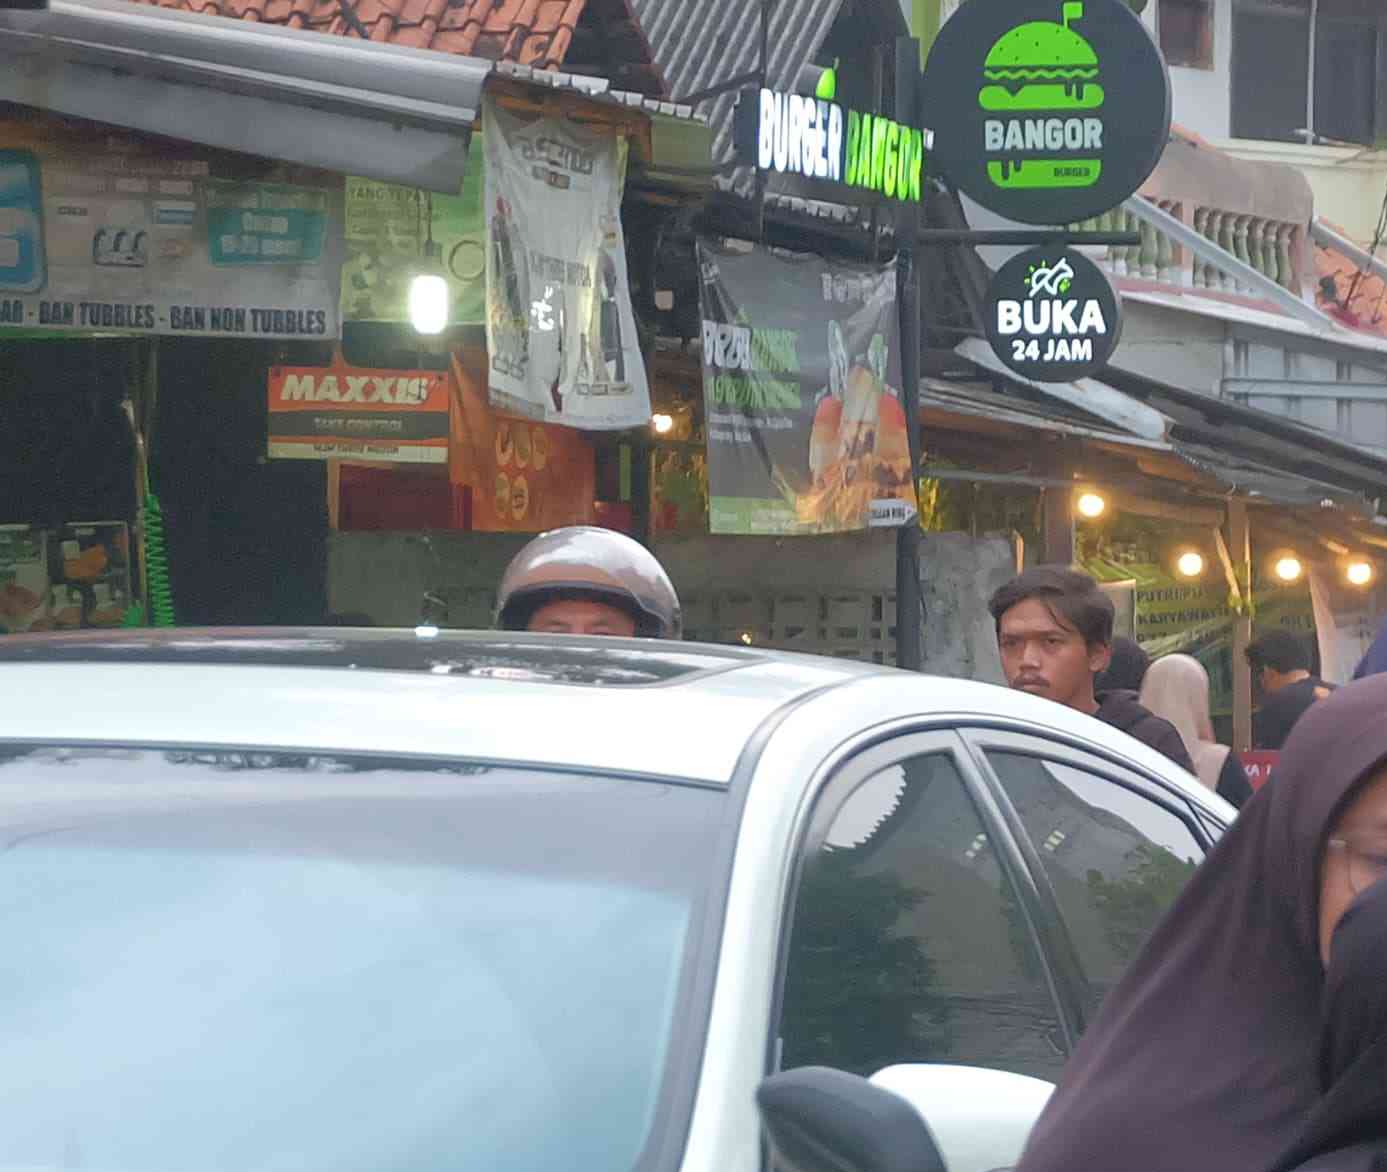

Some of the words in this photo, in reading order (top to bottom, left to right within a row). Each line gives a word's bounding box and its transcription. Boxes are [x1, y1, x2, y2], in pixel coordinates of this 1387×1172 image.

[759, 88, 842, 181] BURGER
[845, 109, 923, 202] BANGOR
[985, 117, 1103, 151] BANGOR
[39, 302, 74, 325] BAN
[170, 305, 206, 331] BAN
[997, 298, 1107, 335] BUKA
[1011, 339, 1040, 361] 24
[1043, 338, 1093, 361] JAM
[280, 373, 429, 405] MAXXIS
